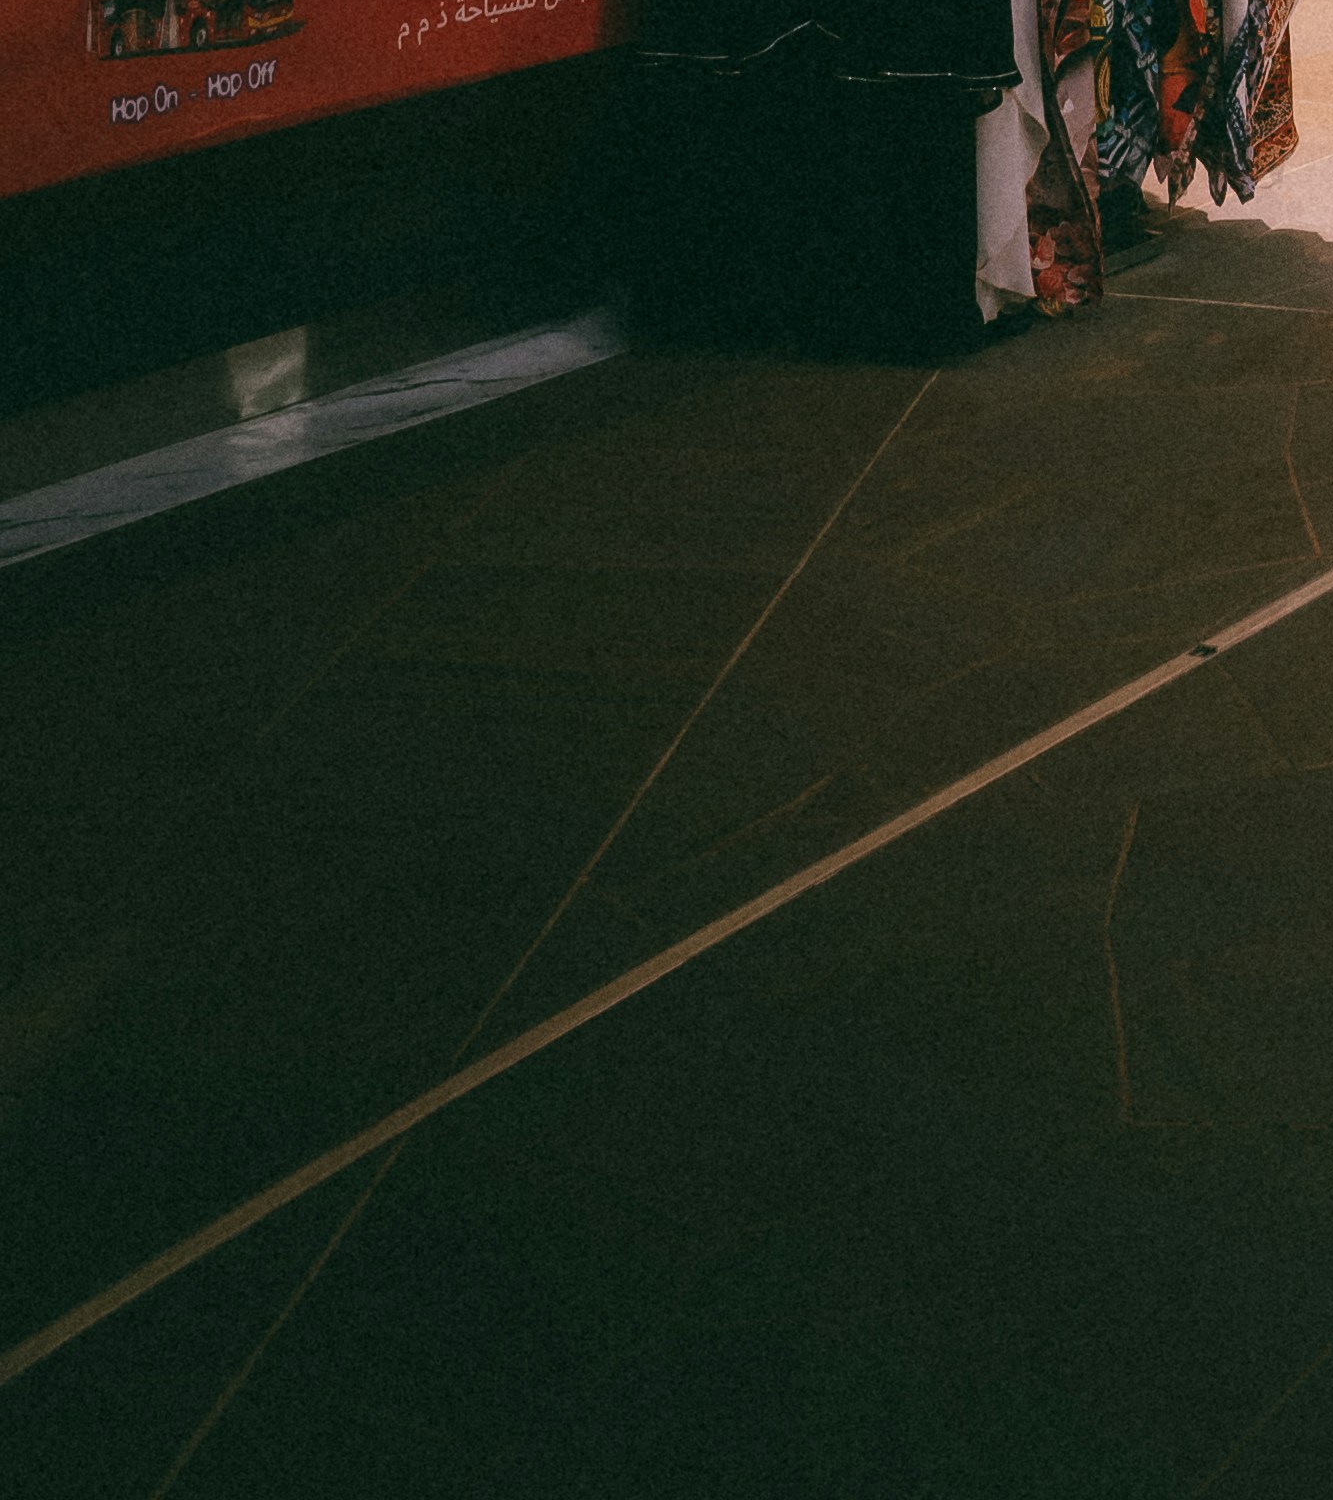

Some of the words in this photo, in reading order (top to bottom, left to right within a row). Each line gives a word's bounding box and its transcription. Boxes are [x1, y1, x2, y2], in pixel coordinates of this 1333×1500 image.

[110, 94, 149, 124] Hop
[153, 84, 179, 113] On
[207, 72, 243, 99] Hop
[247, 59, 278, 90] Off
